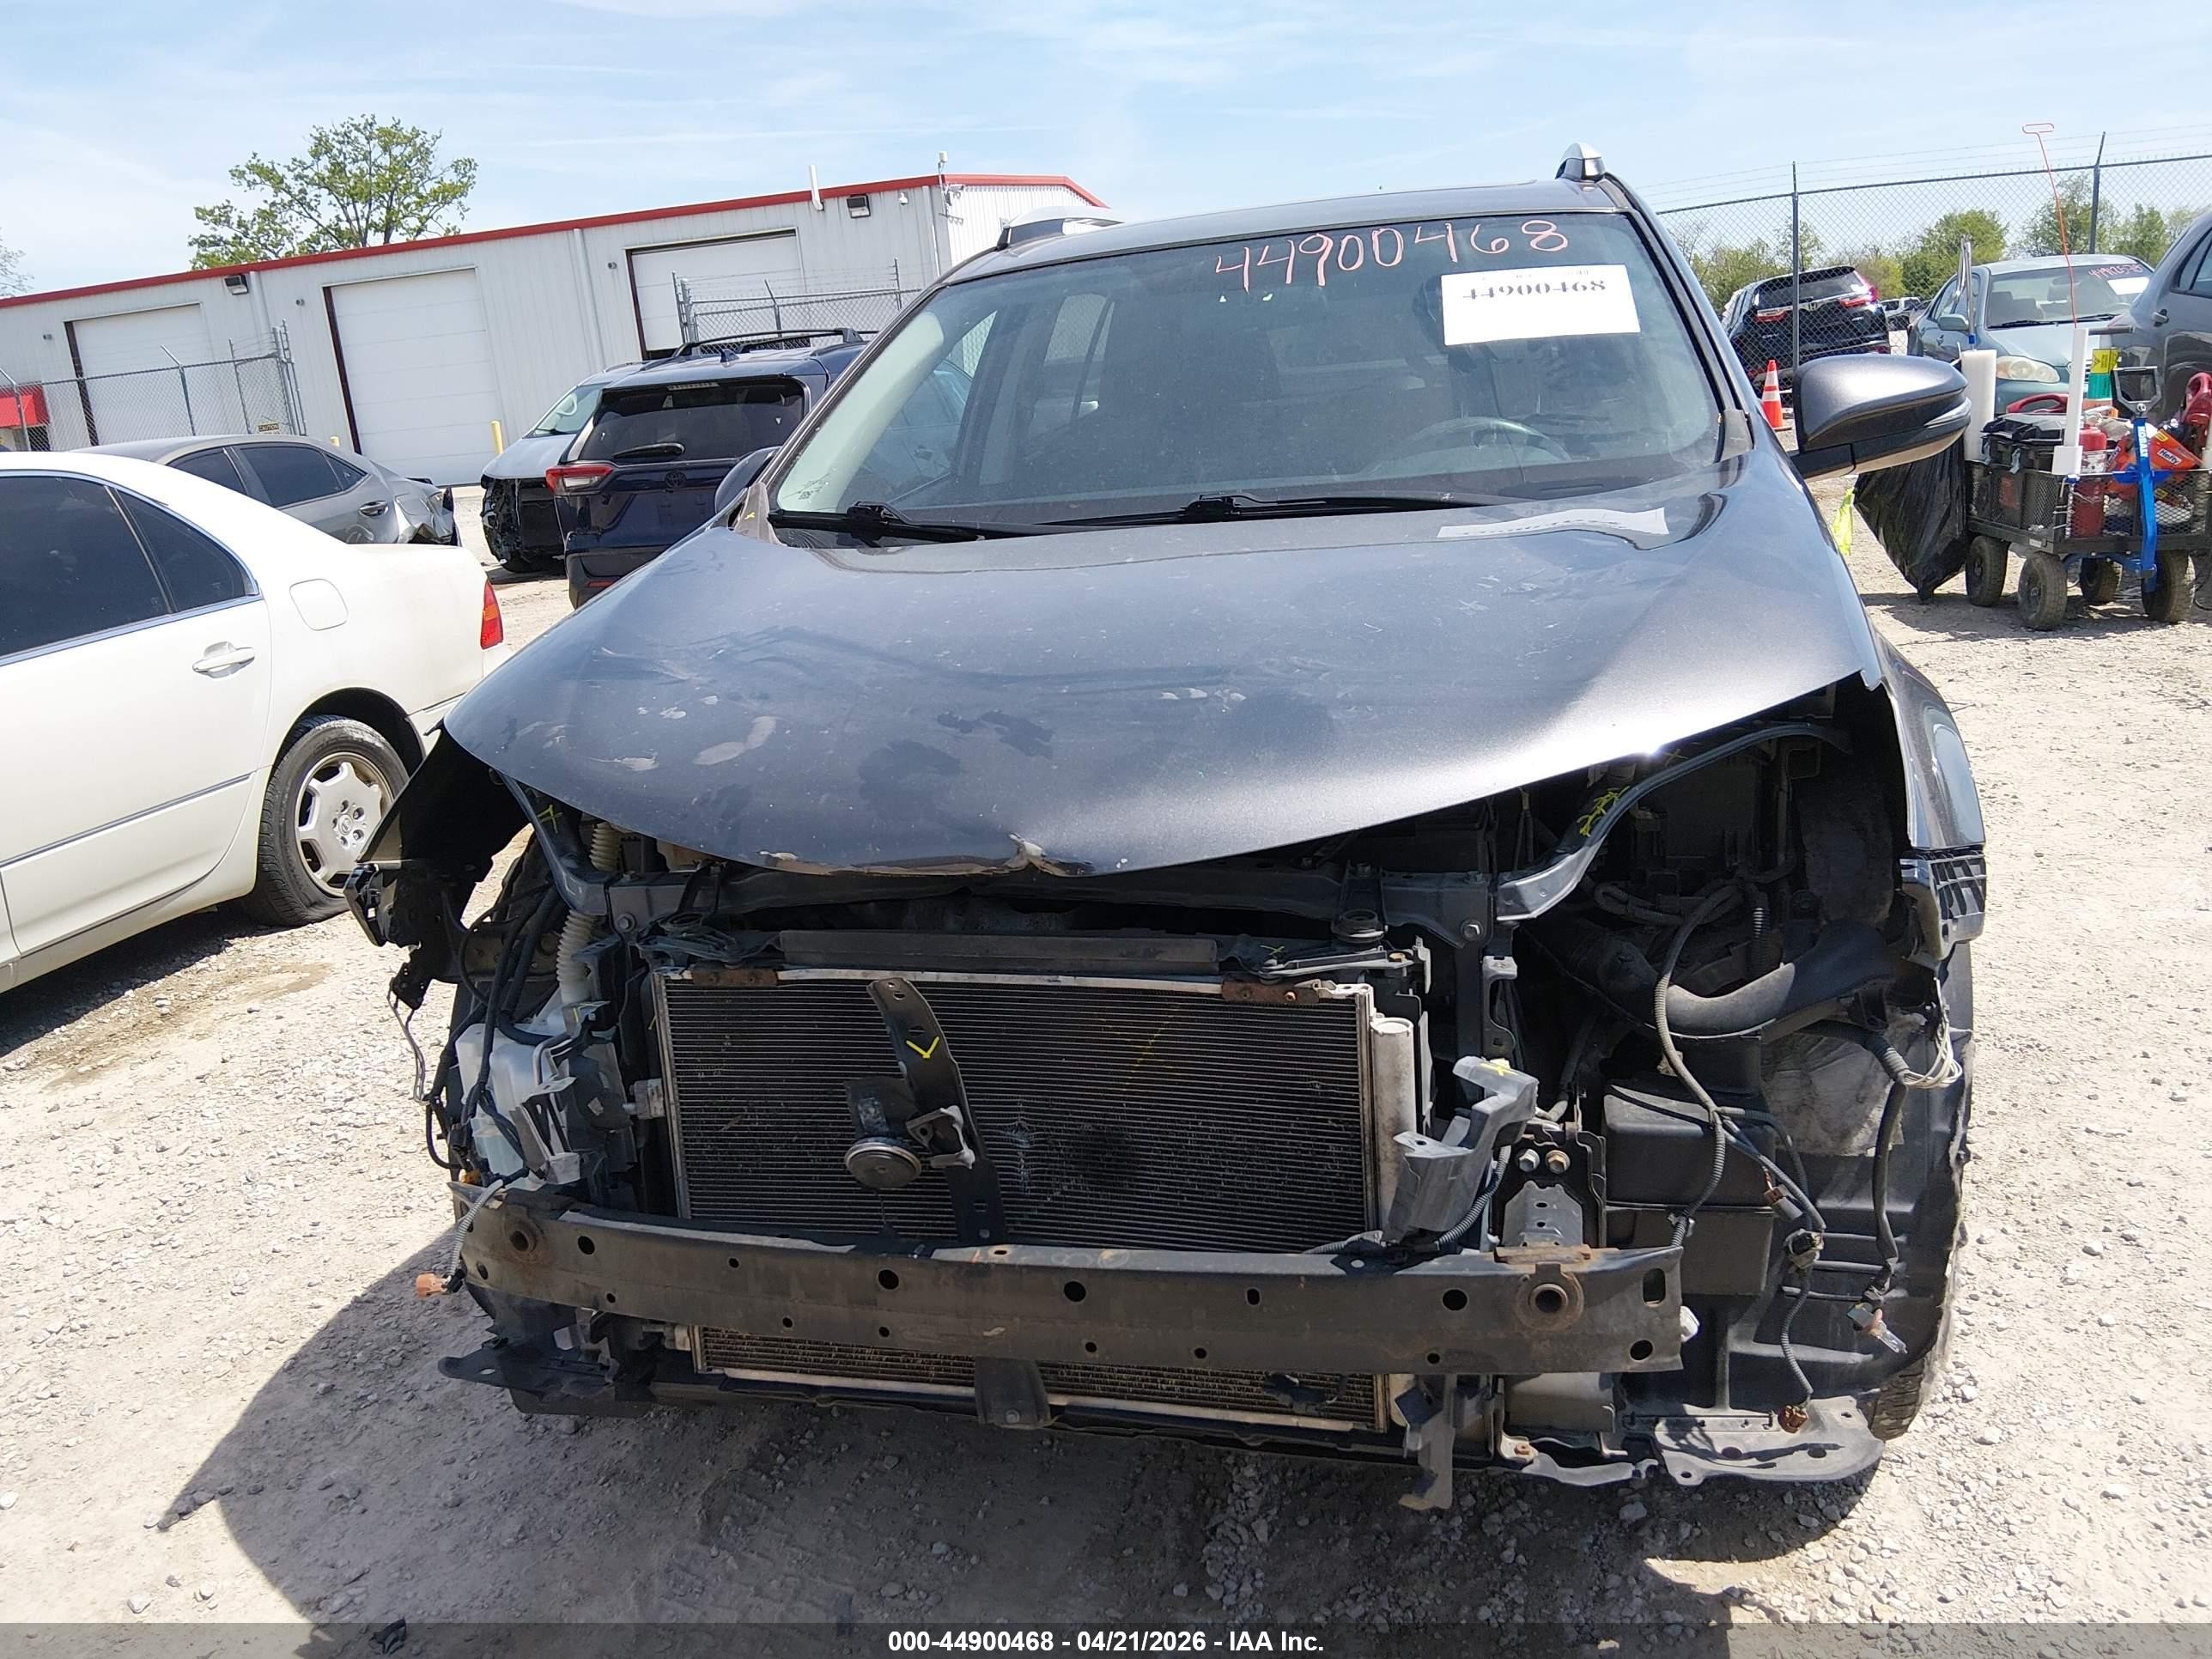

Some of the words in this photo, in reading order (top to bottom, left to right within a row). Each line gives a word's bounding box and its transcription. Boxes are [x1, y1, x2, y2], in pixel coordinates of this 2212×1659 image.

[1215, 219, 1569, 294] 44900468
[1462, 280, 1606, 300] 44900468
[2158, 449, 2180, 464] Hefty
